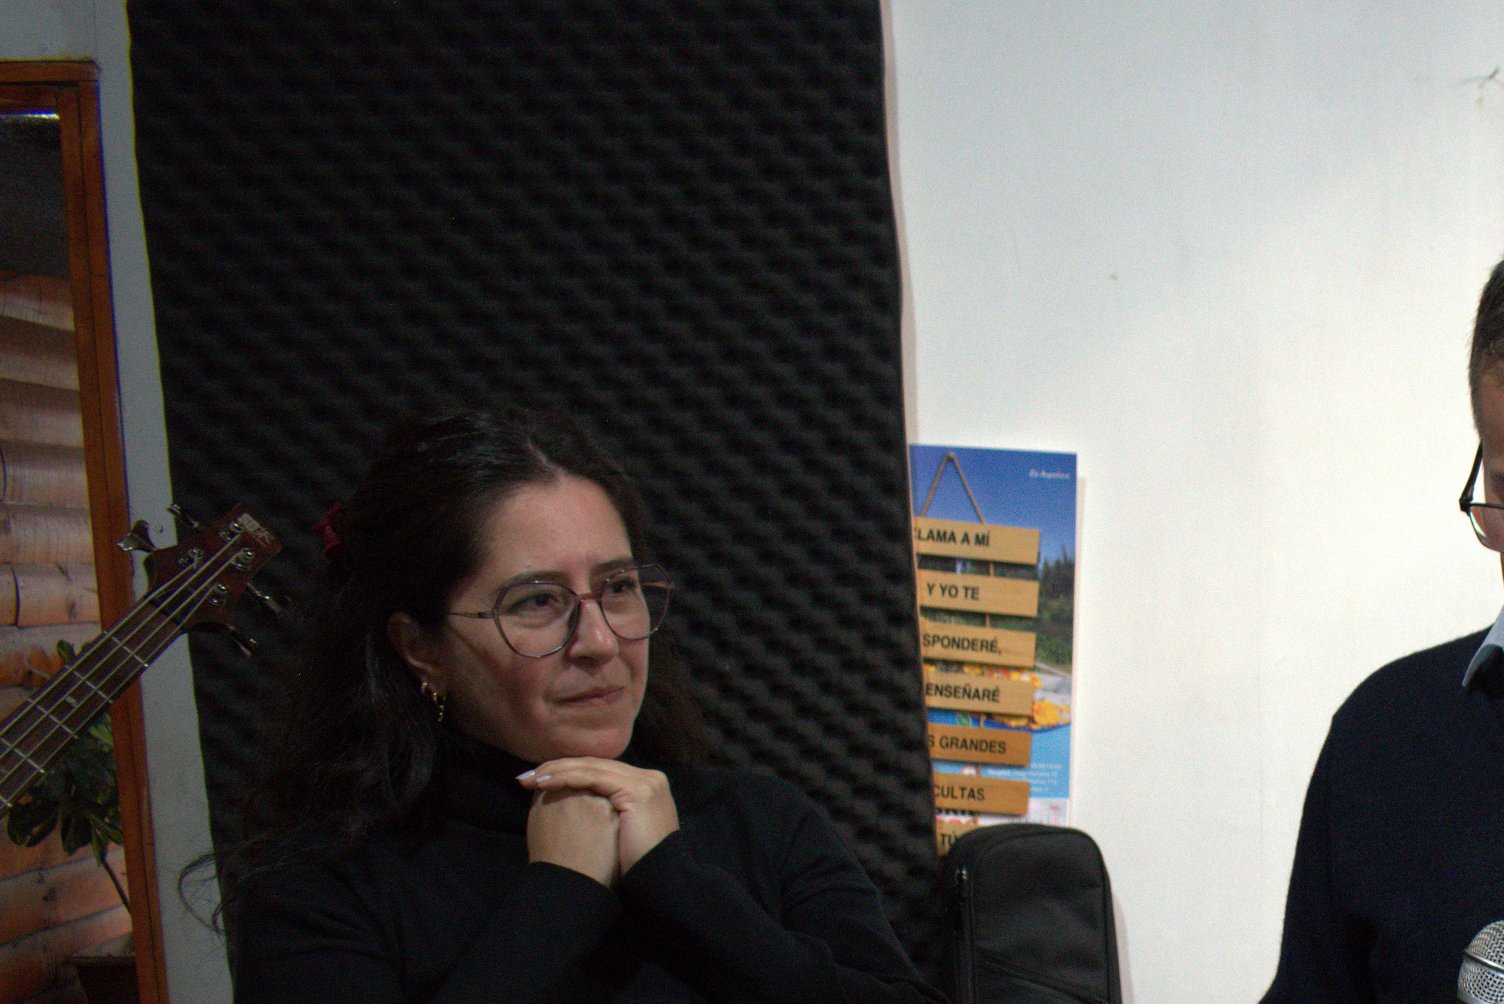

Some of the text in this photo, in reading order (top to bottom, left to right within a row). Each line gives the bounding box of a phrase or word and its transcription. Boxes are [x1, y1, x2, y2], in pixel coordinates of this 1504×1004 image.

[914, 528, 956, 544] LAMA
[960, 531, 970, 545] A
[927, 582, 979, 600] Y YO TE
[925, 683, 1000, 703] ENSEÑARÉ
[939, 735, 1006, 754] GRANDES
